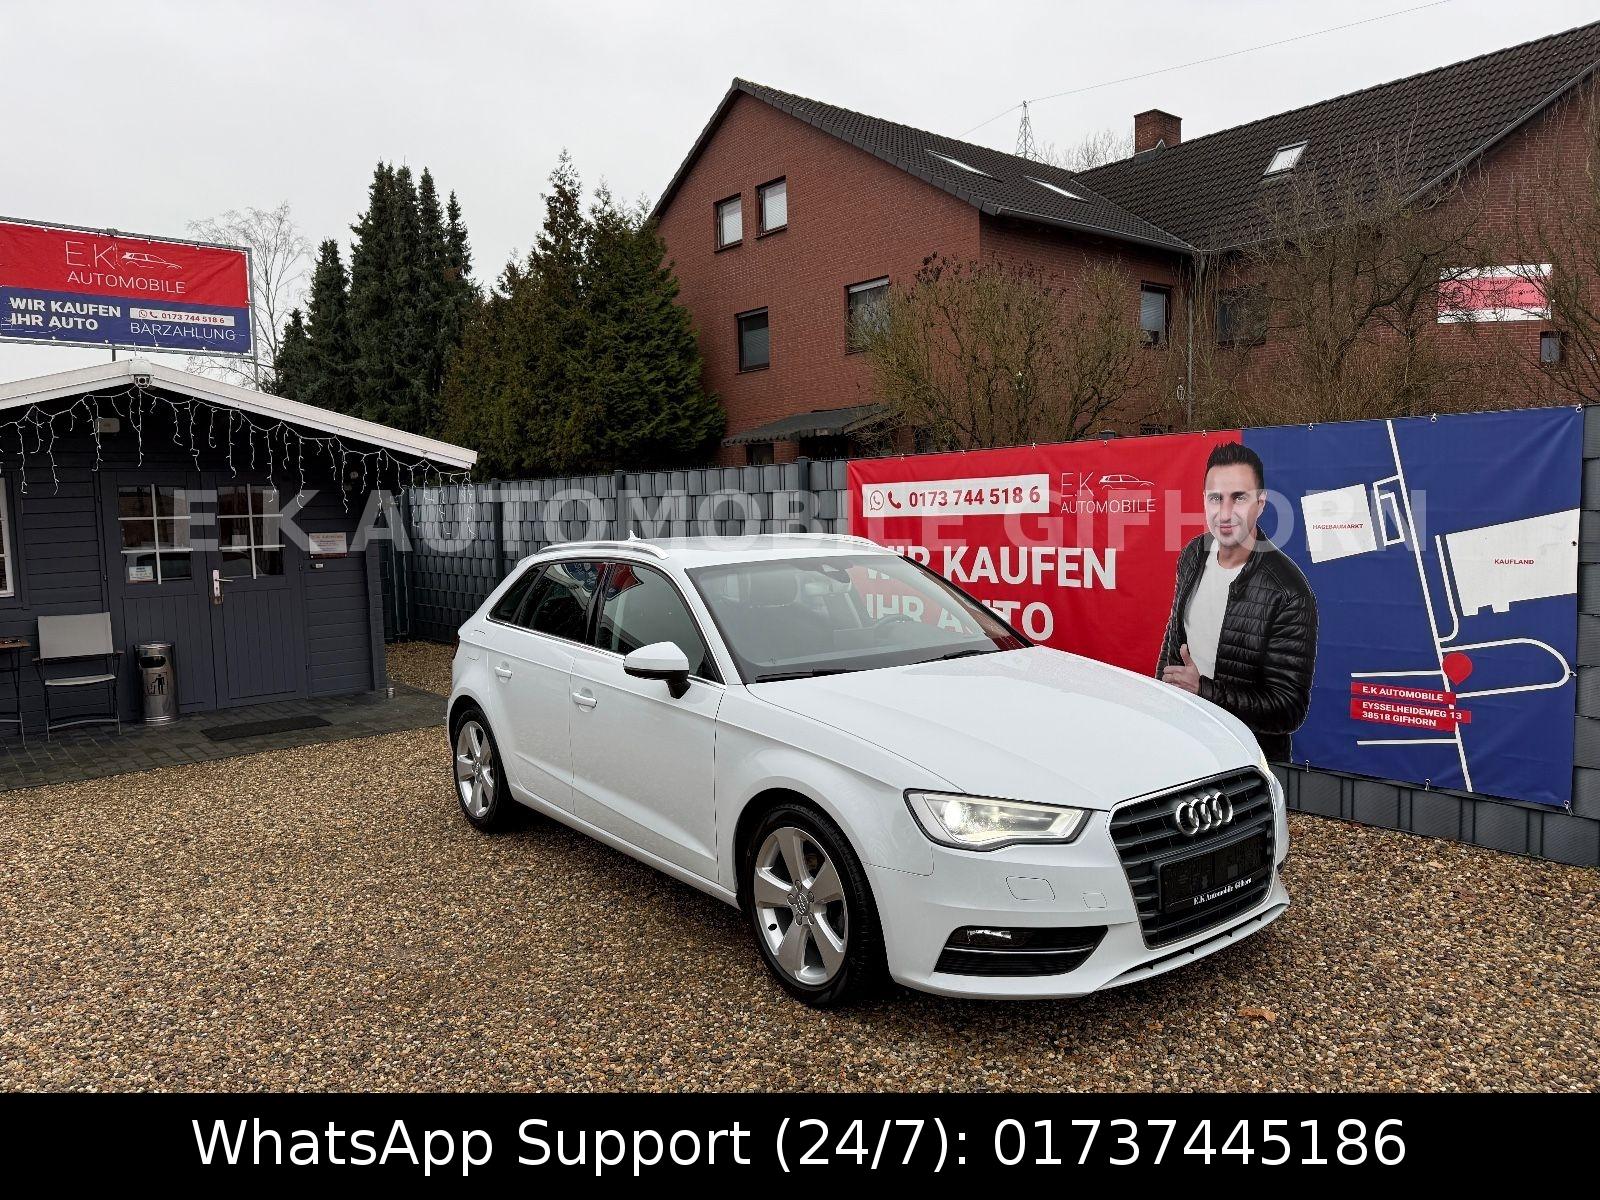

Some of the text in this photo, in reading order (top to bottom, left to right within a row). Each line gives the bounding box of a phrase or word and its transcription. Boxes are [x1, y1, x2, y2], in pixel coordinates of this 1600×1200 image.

[65, 240, 116, 270] E.K
[67, 270, 186, 294] AUTOMOBILE
[9, 296, 121, 318] WIR KAUFEN
[10, 312, 98, 330] IHR AUTO
[161, 312, 183, 321] 0173
[184, 314, 200, 323] 744
[202, 316, 217, 324] 518
[130, 322, 236, 341] BARZAHLUNG
[1060, 471, 1095, 498] E.K
[909, 485, 1041, 508] 0173 744 518 6
[1060, 498, 1157, 514] AUTOMOBILE
[943, 546, 1116, 589] KAUFEN
[866, 593, 926, 622] IHR
[1362, 685, 1443, 702] E.K AUTOMOBILE
[1362, 701, 1462, 720] EYSSELHEIDEWEG 13
[1362, 711, 1437, 727] 38518 GIFHORN
